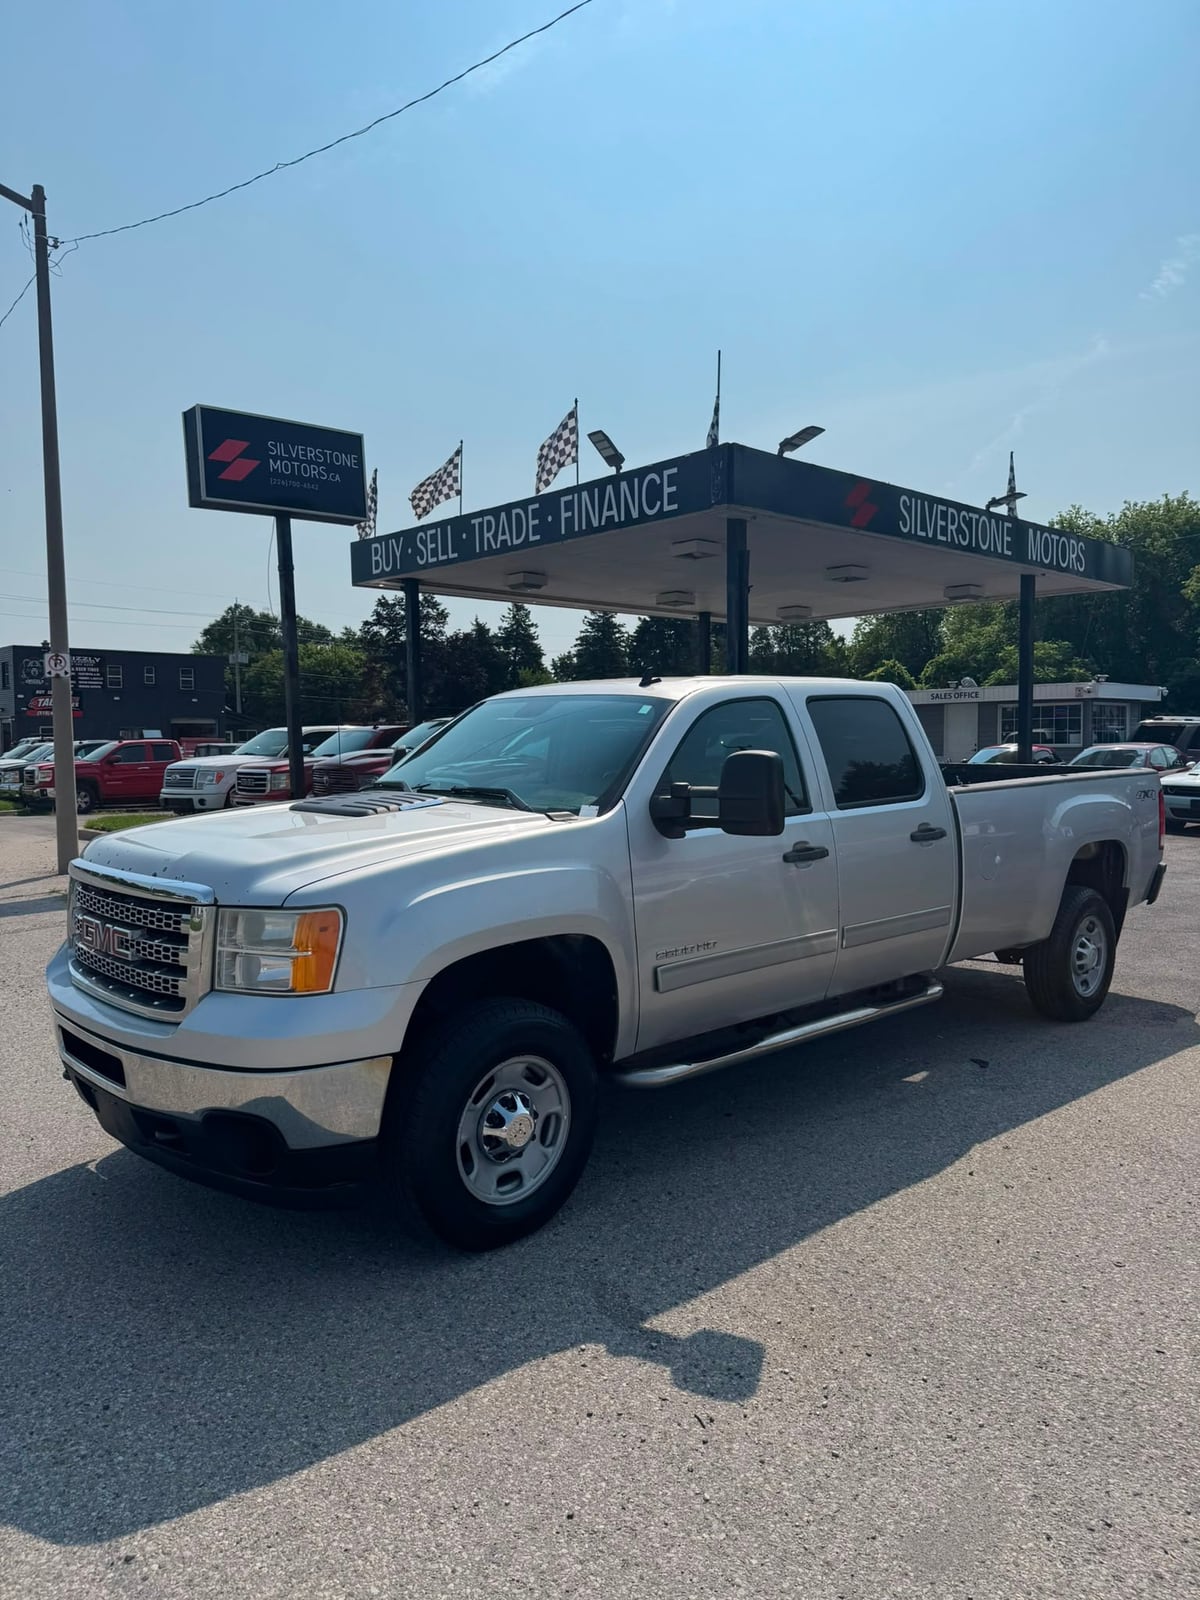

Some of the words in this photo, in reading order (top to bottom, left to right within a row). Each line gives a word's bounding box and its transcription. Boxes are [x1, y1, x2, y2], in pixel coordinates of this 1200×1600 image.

[267, 440, 360, 469] SILVERSTONE
[371, 537, 404, 575] BUY
[416, 525, 458, 565] SELL
[471, 503, 541, 553] TRADE
[560, 467, 678, 535] FINANCE
[899, 494, 1013, 556] SILVERSTONE
[1028, 527, 1086, 573] MOTORS
[930, 692, 952, 701] SALES
[953, 691, 979, 699] OFFICE
[80, 915, 134, 961] GMC
